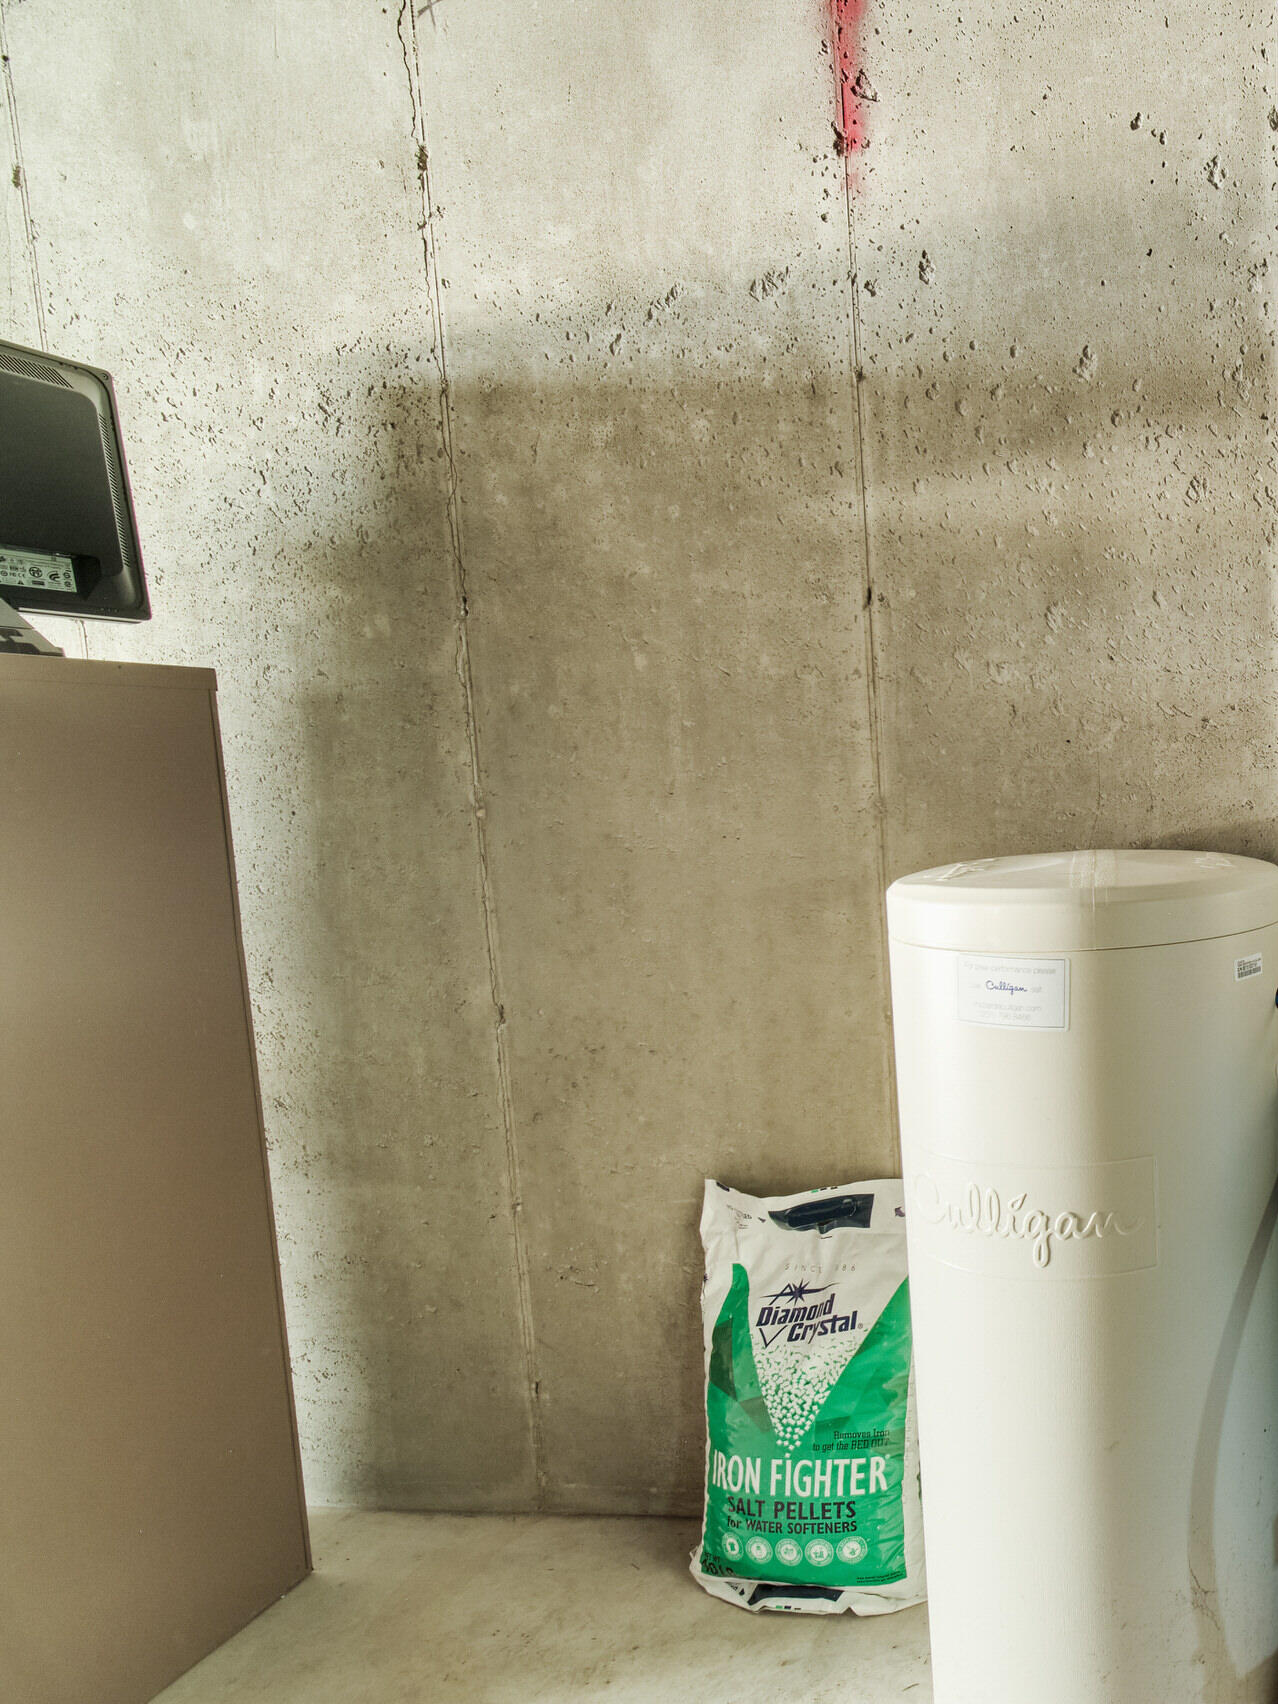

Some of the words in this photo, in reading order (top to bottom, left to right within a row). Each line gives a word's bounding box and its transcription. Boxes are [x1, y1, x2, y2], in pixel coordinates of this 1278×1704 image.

[985, 980, 1028, 996] Culligan
[914, 1172, 1146, 1268] Culligan
[756, 1293, 836, 1327] Diamond
[786, 1310, 858, 1344] Crystal
[822, 1442, 834, 1453] get
[836, 1441, 849, 1450] the
[850, 1439, 869, 1450] RED
[712, 1450, 761, 1495] IRON
[769, 1455, 889, 1497] FIGHTER
[727, 1495, 766, 1519] SALT
[773, 1500, 857, 1520] PELLETS
[727, 1517, 741, 1529] for
[746, 1518, 783, 1534] WATER
[787, 1520, 858, 1535] SOFTENERS
